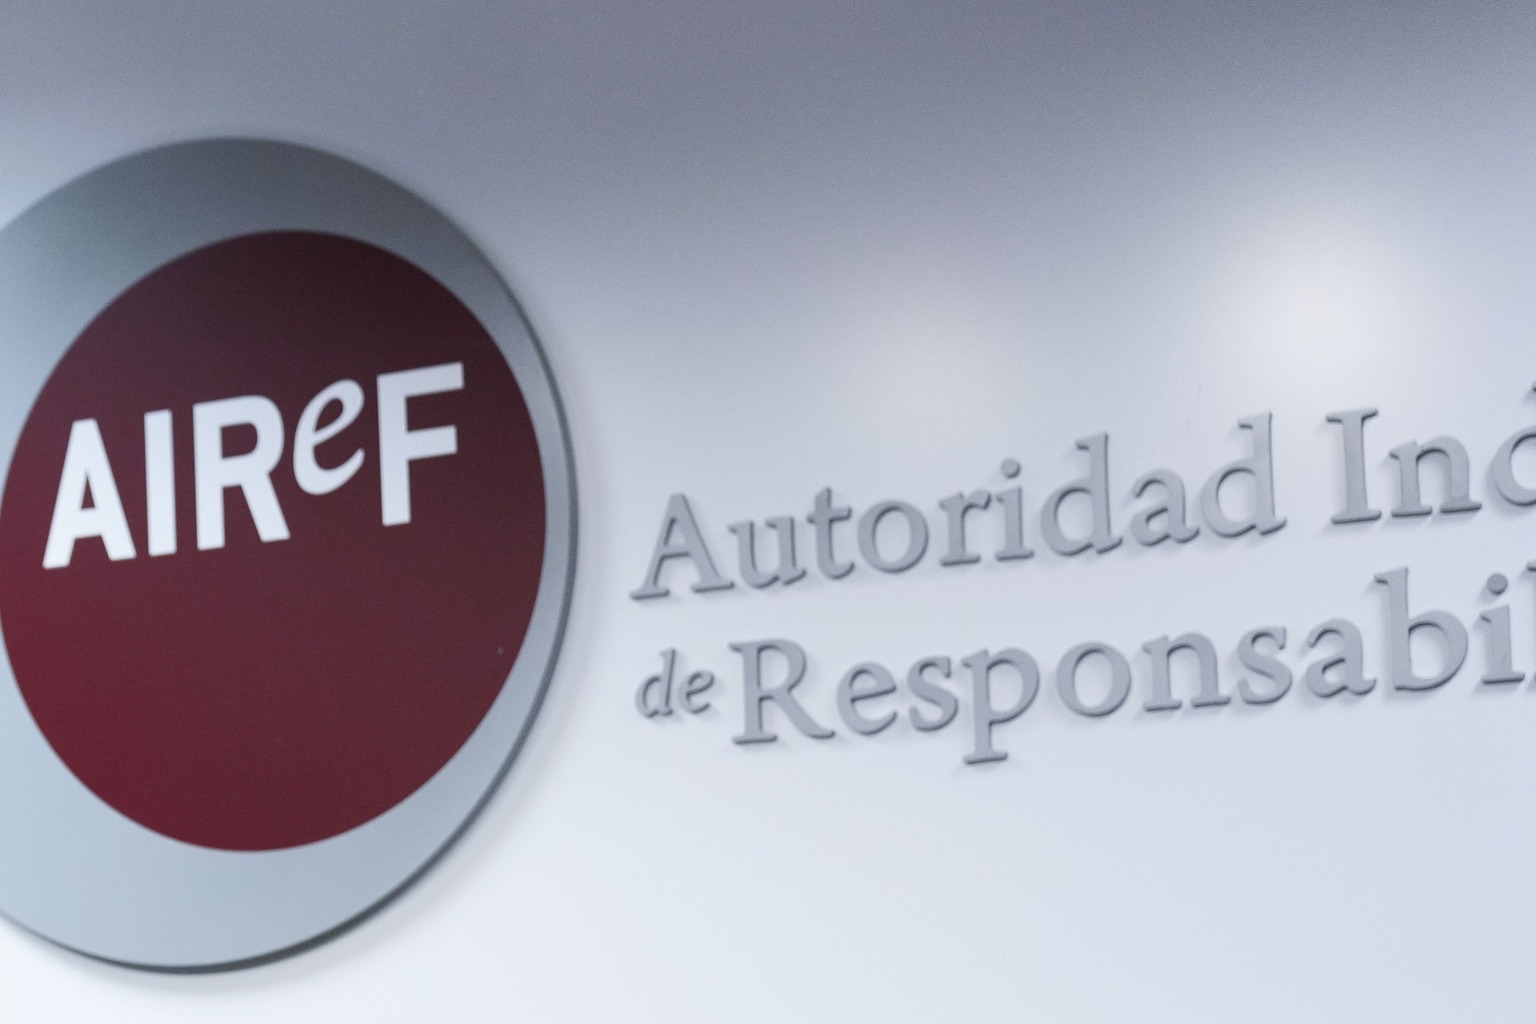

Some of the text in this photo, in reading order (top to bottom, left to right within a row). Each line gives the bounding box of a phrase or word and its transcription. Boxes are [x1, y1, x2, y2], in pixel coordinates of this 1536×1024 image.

[42, 361, 465, 570] AIReF
[629, 411, 1288, 601] Autoridad
[636, 560, 1536, 766] de Responsabi
